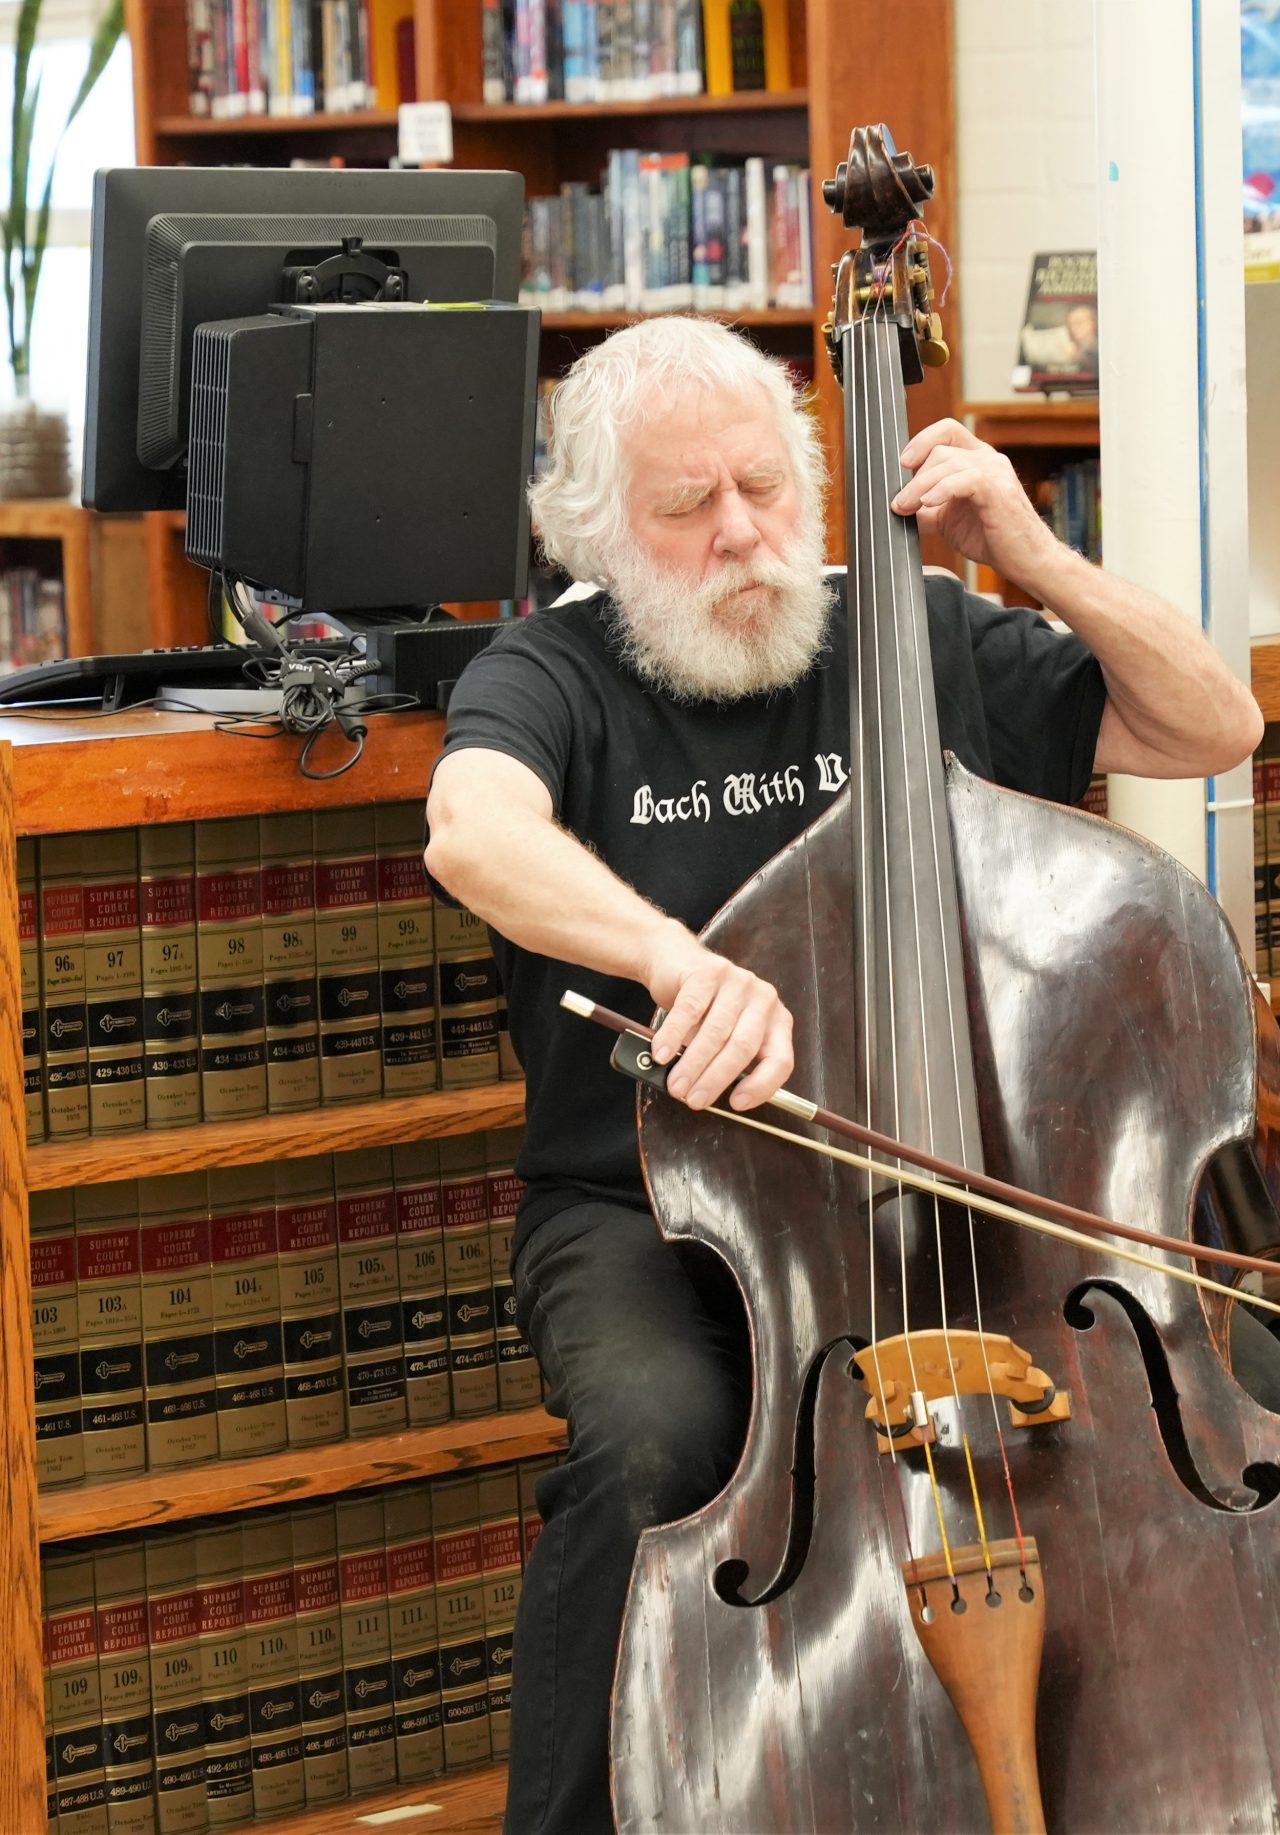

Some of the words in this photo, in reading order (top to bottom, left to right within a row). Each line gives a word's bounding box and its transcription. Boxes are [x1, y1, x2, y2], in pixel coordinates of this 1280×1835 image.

[630, 780, 711, 825] Bach
[723, 765, 805, 816] With
[89, 889, 135, 903] SUPREME
[98, 902, 129, 914] COURT
[89, 914, 139, 928] REPORTER
[341, 926, 357, 942] 99
[107, 950, 124, 968] 97
[89, 1236, 130, 1250] SUPREME
[96, 1249, 125, 1263] COURT
[414, 1250, 435, 1268] 106
[87, 1261, 132, 1276] REPORTER
[303, 1267, 325, 1285] 105
[169, 1287, 192, 1306] 104
[493, 1584, 515, 1603] 112
[52, 1618, 91, 1635] SUPREME
[357, 1617, 379, 1635] 111
[58, 1632, 86, 1646] COURT
[52, 1641, 96, 1661] REPORTER
[213, 1648, 237, 1668] 110
[63, 1677, 88, 1698] 109
